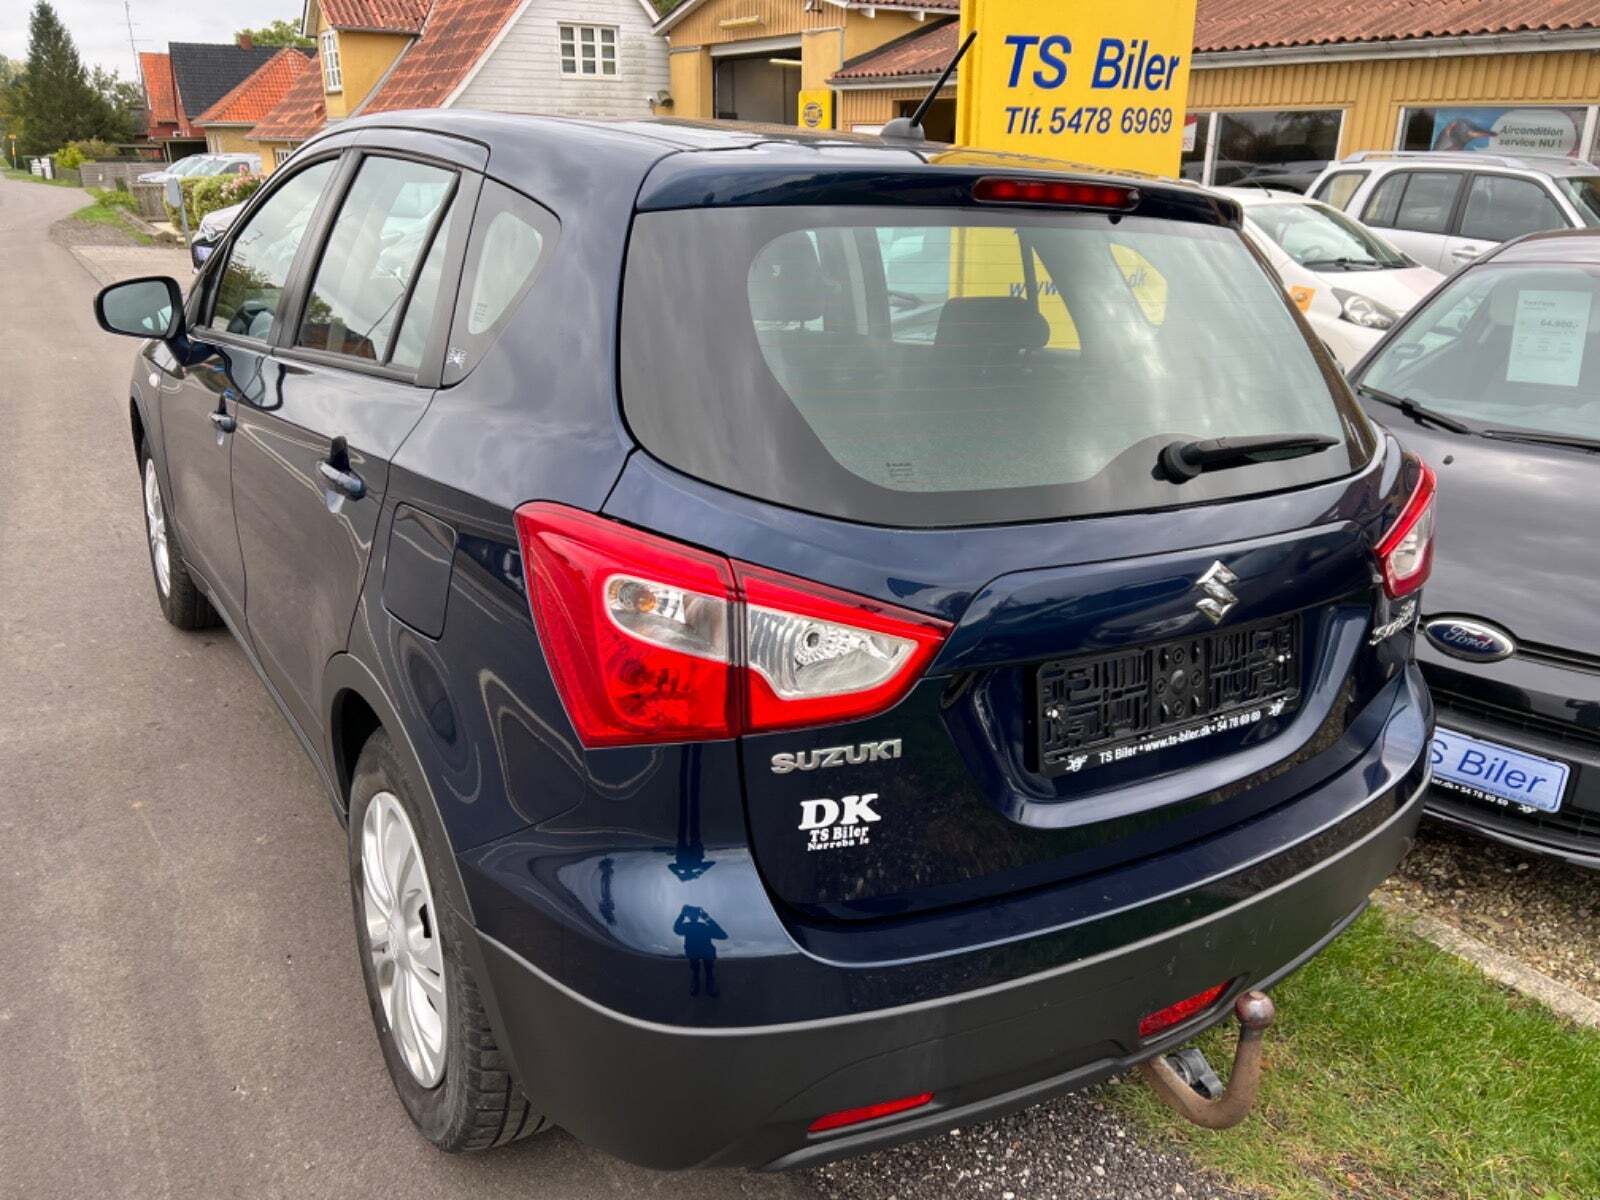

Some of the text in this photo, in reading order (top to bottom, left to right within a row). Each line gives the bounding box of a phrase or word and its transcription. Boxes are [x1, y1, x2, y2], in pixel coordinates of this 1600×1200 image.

[1004, 35, 1180, 91] TS Biler
[1005, 106, 1172, 134] Tlf. 5478 6969
[1500, 124, 1565, 137] Aircondition
[1498, 138, 1536, 148] service
[1442, 625, 1493, 651] Ford
[770, 738, 902, 774] SUZUKI
[1099, 750, 1114, 764] TS
[1115, 746, 1138, 760] Biler
[1457, 749, 1548, 793] Biler
[798, 793, 882, 831] DK
[809, 825, 869, 842] TS Biler
